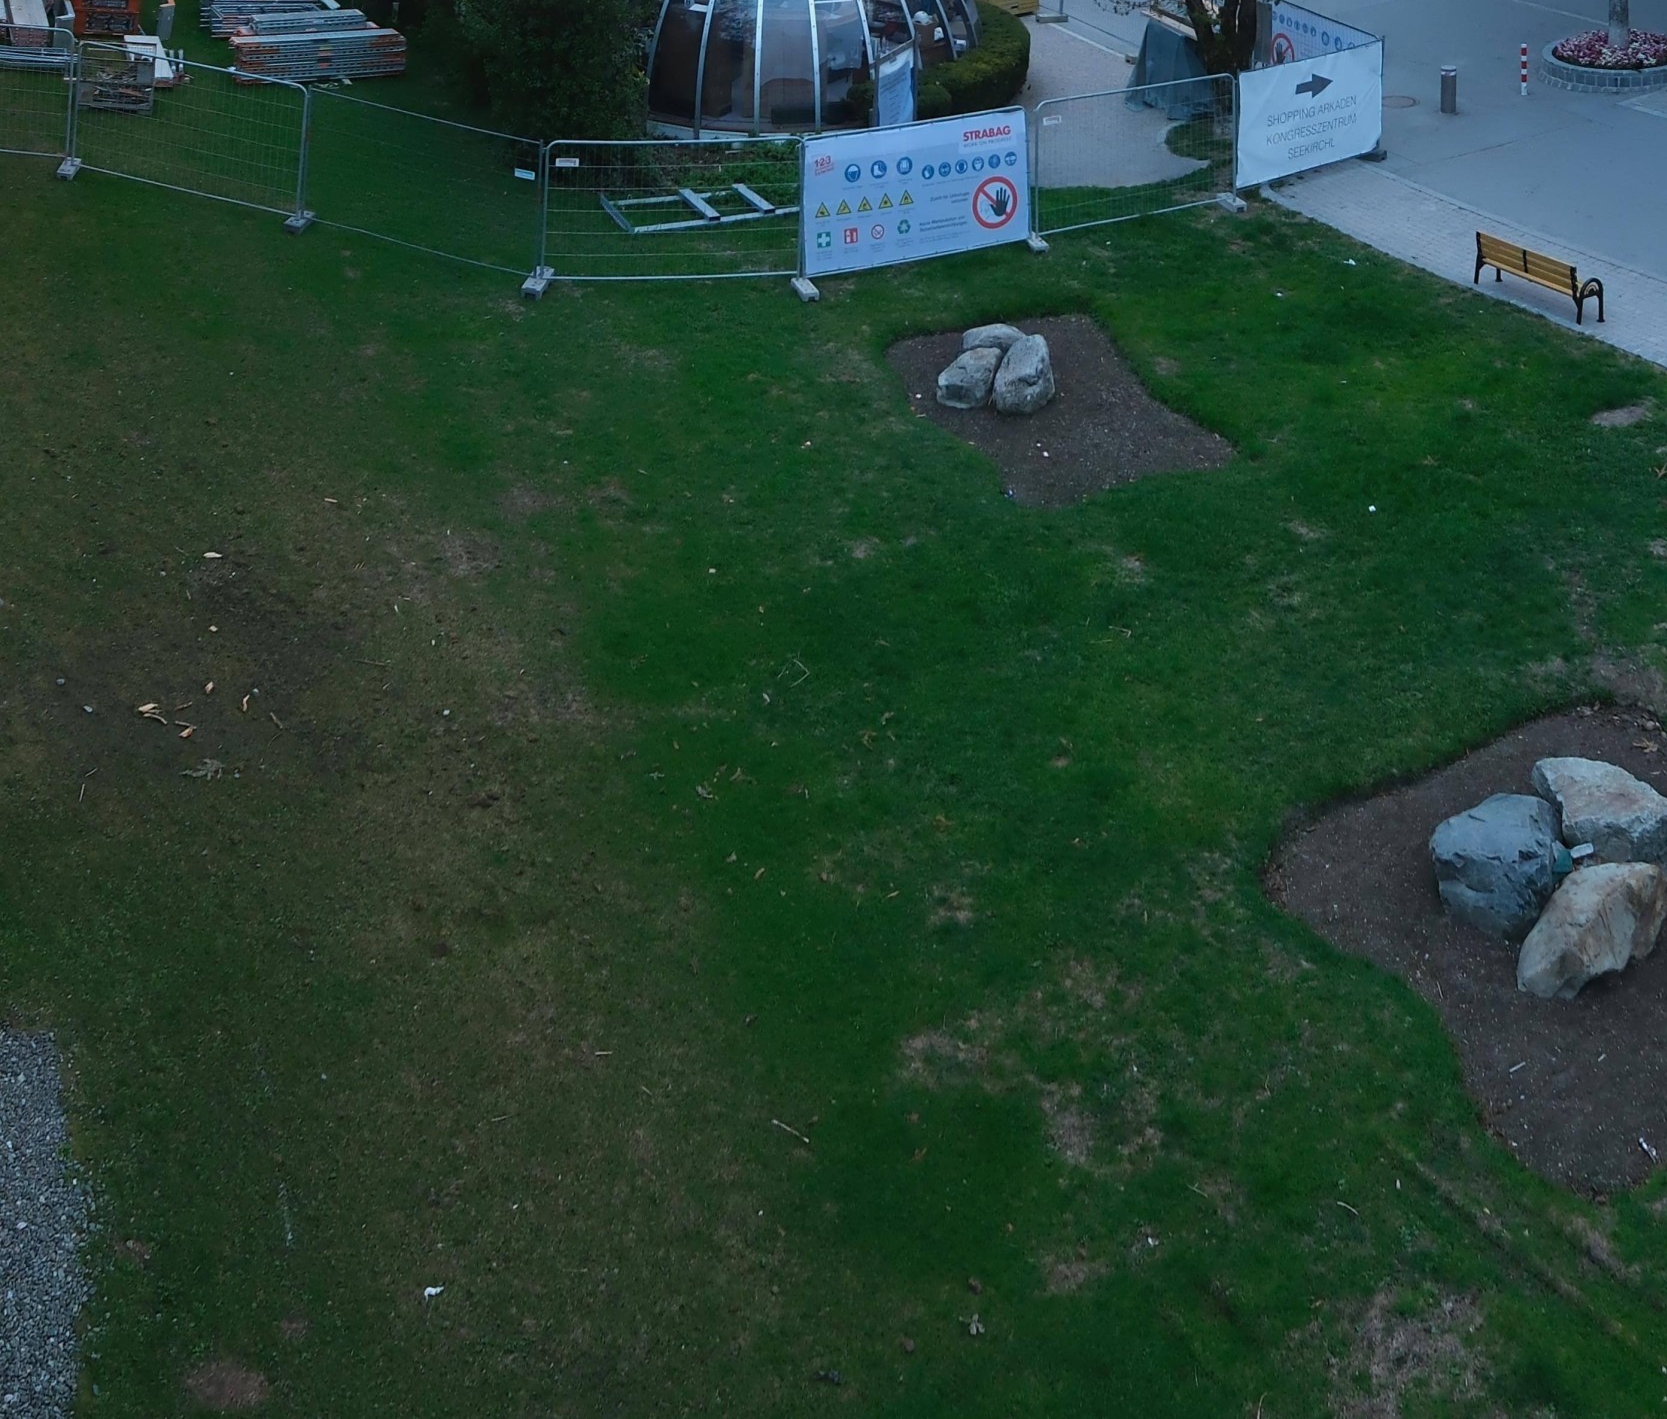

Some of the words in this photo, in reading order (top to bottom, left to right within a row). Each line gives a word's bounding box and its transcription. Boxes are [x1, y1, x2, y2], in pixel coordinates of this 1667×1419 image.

[1267, 106, 1315, 127] SHOPPING
[1317, 95, 1357, 115] ARKADEN
[963, 125, 1011, 141] STRABAG
[1266, 114, 1357, 146] KONGRESSZENTRUM
[1287, 138, 1335, 159] SEEKIRCHL
